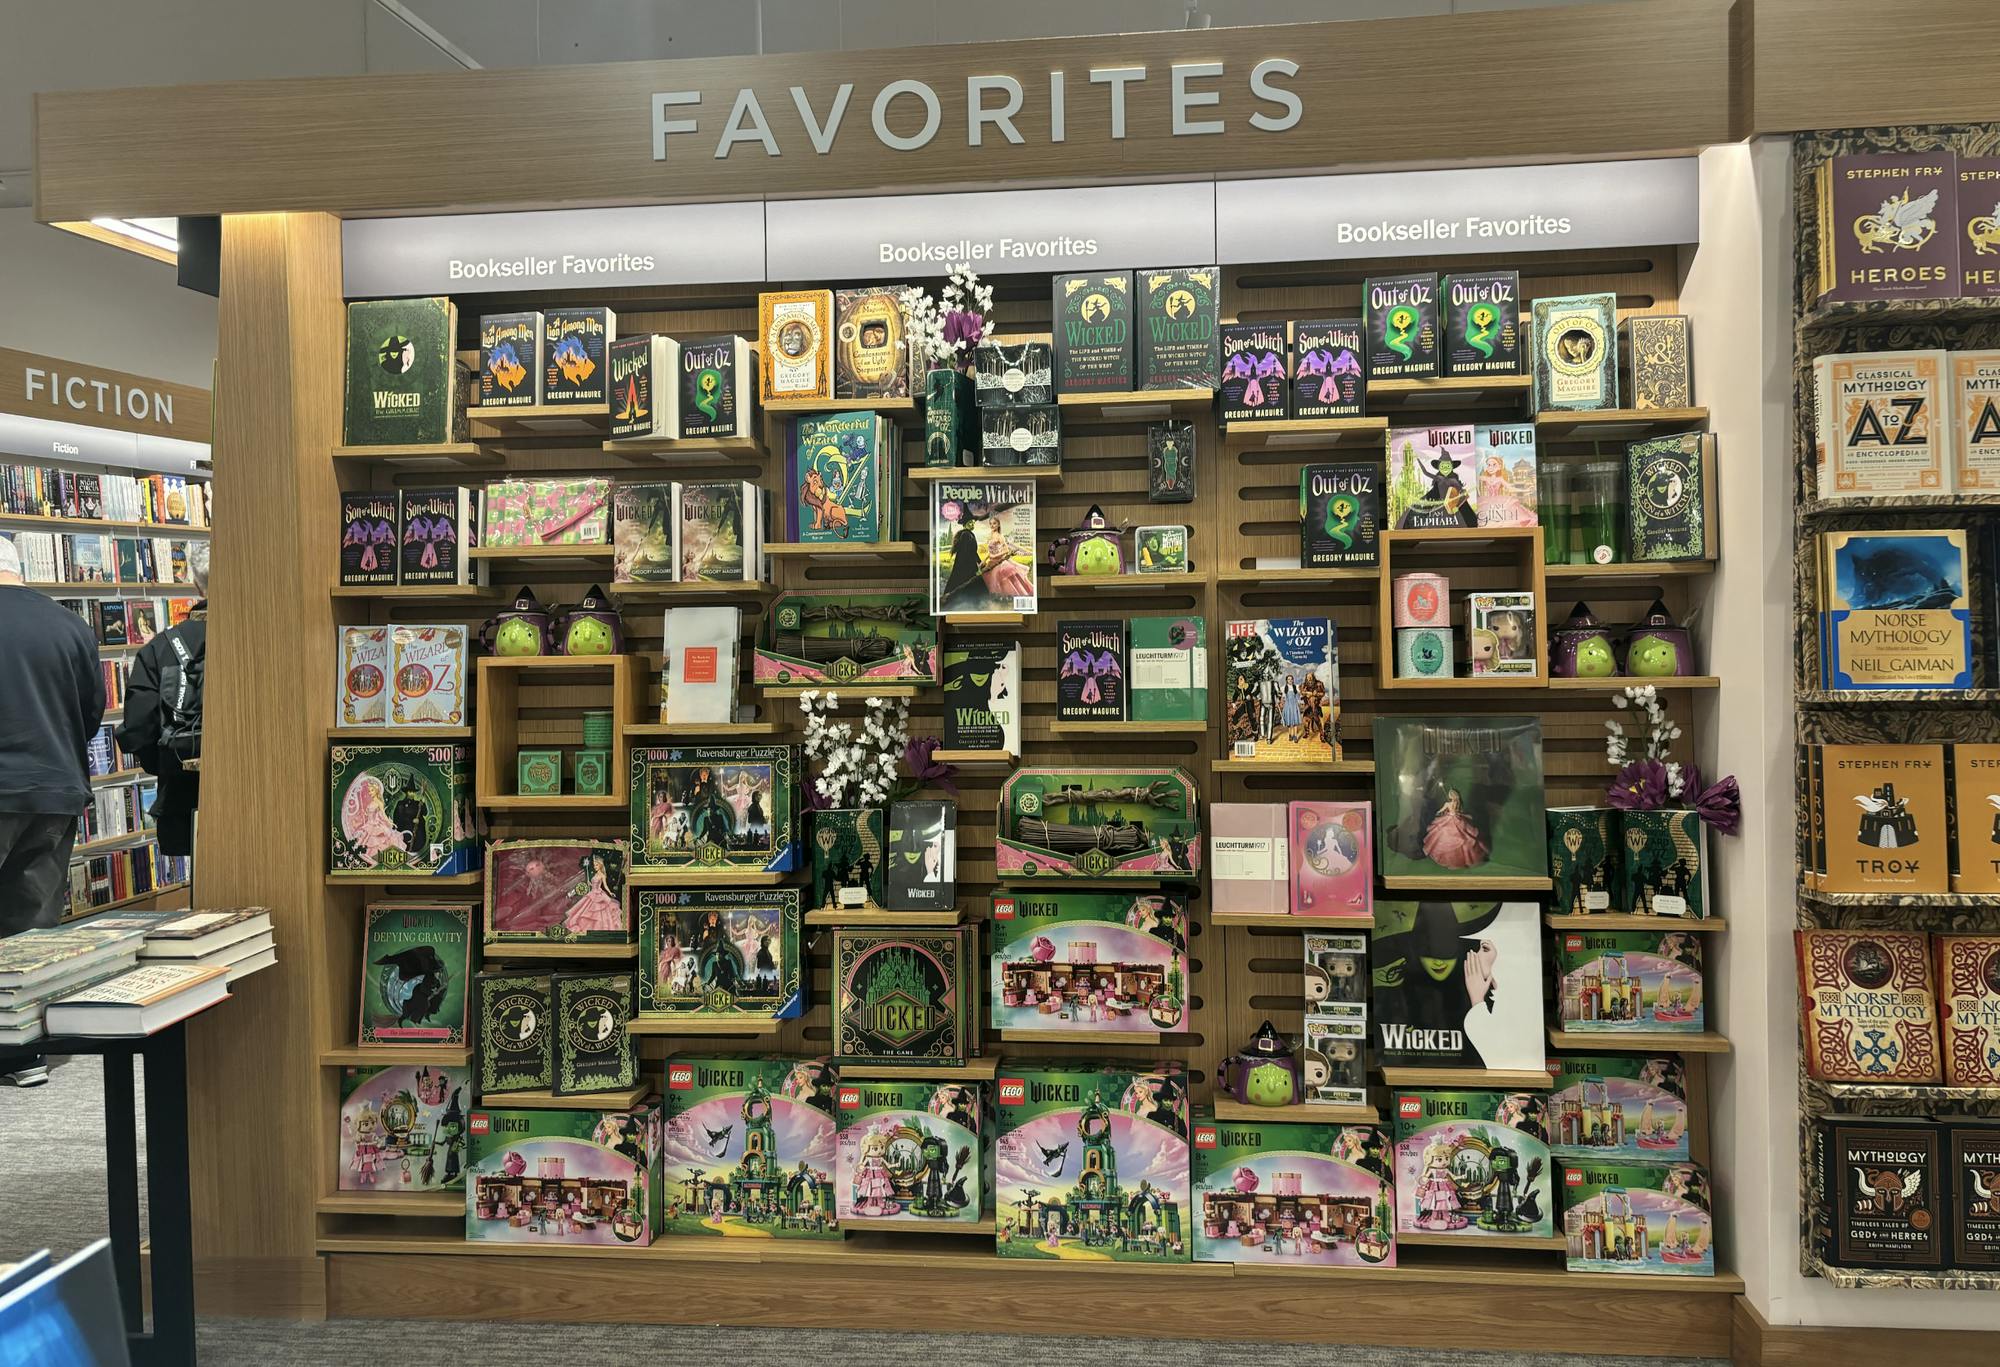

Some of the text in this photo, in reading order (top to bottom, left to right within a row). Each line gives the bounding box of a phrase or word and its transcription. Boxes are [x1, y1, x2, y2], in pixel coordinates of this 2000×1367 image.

[651, 58, 1303, 160] FAVORITES
[1847, 167, 1943, 179] STEPHEN FRY
[1960, 171, 2000, 181] STEPH
[1337, 215, 1571, 243] Bookseller Favorites
[878, 235, 1098, 264] Bookseller Favorites
[448, 252, 654, 280] Bookseller Favorites
[1851, 267, 1946, 283] HEROES
[1372, 283, 1432, 309] Out of Oz
[547, 317, 603, 340] Lion Among Men
[1065, 319, 1126, 347] WICKED
[1149, 314, 1212, 342] WICKED
[1299, 333, 1319, 354] Son
[1328, 330, 1359, 353] Witch
[612, 350, 648, 382] Wicked
[1372, 363, 1434, 375] GREGORY MAGUIRE
[1856, 370, 1912, 379] CLASSICAL
[1844, 380, 1927, 393] MYTHOLOGY
[26, 368, 173, 424] FICTION
[547, 390, 602, 399] GREGORY MAGUIRE
[1299, 405, 1359, 416] GREGORY MAGUIRE
[612, 421, 651, 434] GREGORY MAGUIRE
[816, 419, 869, 433] Wonderful
[1848, 398, 1927, 446] A TO Z
[802, 433, 838, 446] Wizard
[1428, 429, 1471, 447] WICKED
[1489, 429, 1533, 447] WICKED
[53, 442, 79, 455] Fiction
[1856, 450, 1919, 458] ENCYCLOPEDIA
[1645, 459, 1682, 477] WICKED
[1312, 474, 1372, 496] Out of Oz
[942, 485, 1030, 504] People Wicked
[1641, 498, 1654, 515] SON
[1664, 494, 1689, 516] WITCH
[685, 504, 722, 521] WICKED
[1413, 515, 1459, 527] ELPHABA
[1345, 553, 1375, 561] MAGUIRE
[1875, 614, 1927, 626] NORSE
[1230, 624, 1254, 636] LIFE
[1273, 626, 1325, 636] WIZARD
[1063, 632, 1081, 654] Son
[1091, 632, 1120, 654] Witch
[1295, 637, 1312, 647] OZ
[1850, 630, 1952, 645] MYTHOLOGY
[1136, 652, 1185, 660] LEUCHTTURM1917
[1851, 659, 1954, 673] NEIL GAIMAN
[1063, 707, 1119, 715] GREGORY MAGUIRE
[428, 748, 450, 762] 500
[646, 749, 668, 761] 1000
[696, 748, 774, 758] Ravensburger Puzzle
[1838, 760, 1932, 769] STEPHEN FRY
[1856, 860, 1920, 873] TROY
[995, 901, 1058, 918] LEGO WICKED
[374, 932, 462, 942] DEFYING GRAVITY
[1585, 937, 1616, 949] WICKED
[576, 998, 613, 1012] WICKED
[1845, 993, 1899, 1005] NORSE
[859, 998, 936, 1035] WICKED
[1820, 1005, 1927, 1019] MYTHOLOGY
[571, 1032, 585, 1047] SON
[594, 1029, 620, 1050] WITCH
[672, 1067, 744, 1088] LEGO WICKED
[1001, 1080, 1079, 1103] LEGO WICKED
[841, 1090, 903, 1108] LEGO WICKED
[1401, 1099, 1468, 1117] LEGO WICKED
[1197, 1131, 1261, 1147] LEGO WICKED
[1848, 1150, 1926, 1163] MYTHOLOGY
[1586, 1171, 1619, 1185] WICKED
[1851, 1230, 1877, 1240] GODS
[1891, 1231, 1928, 1240] HEROES
